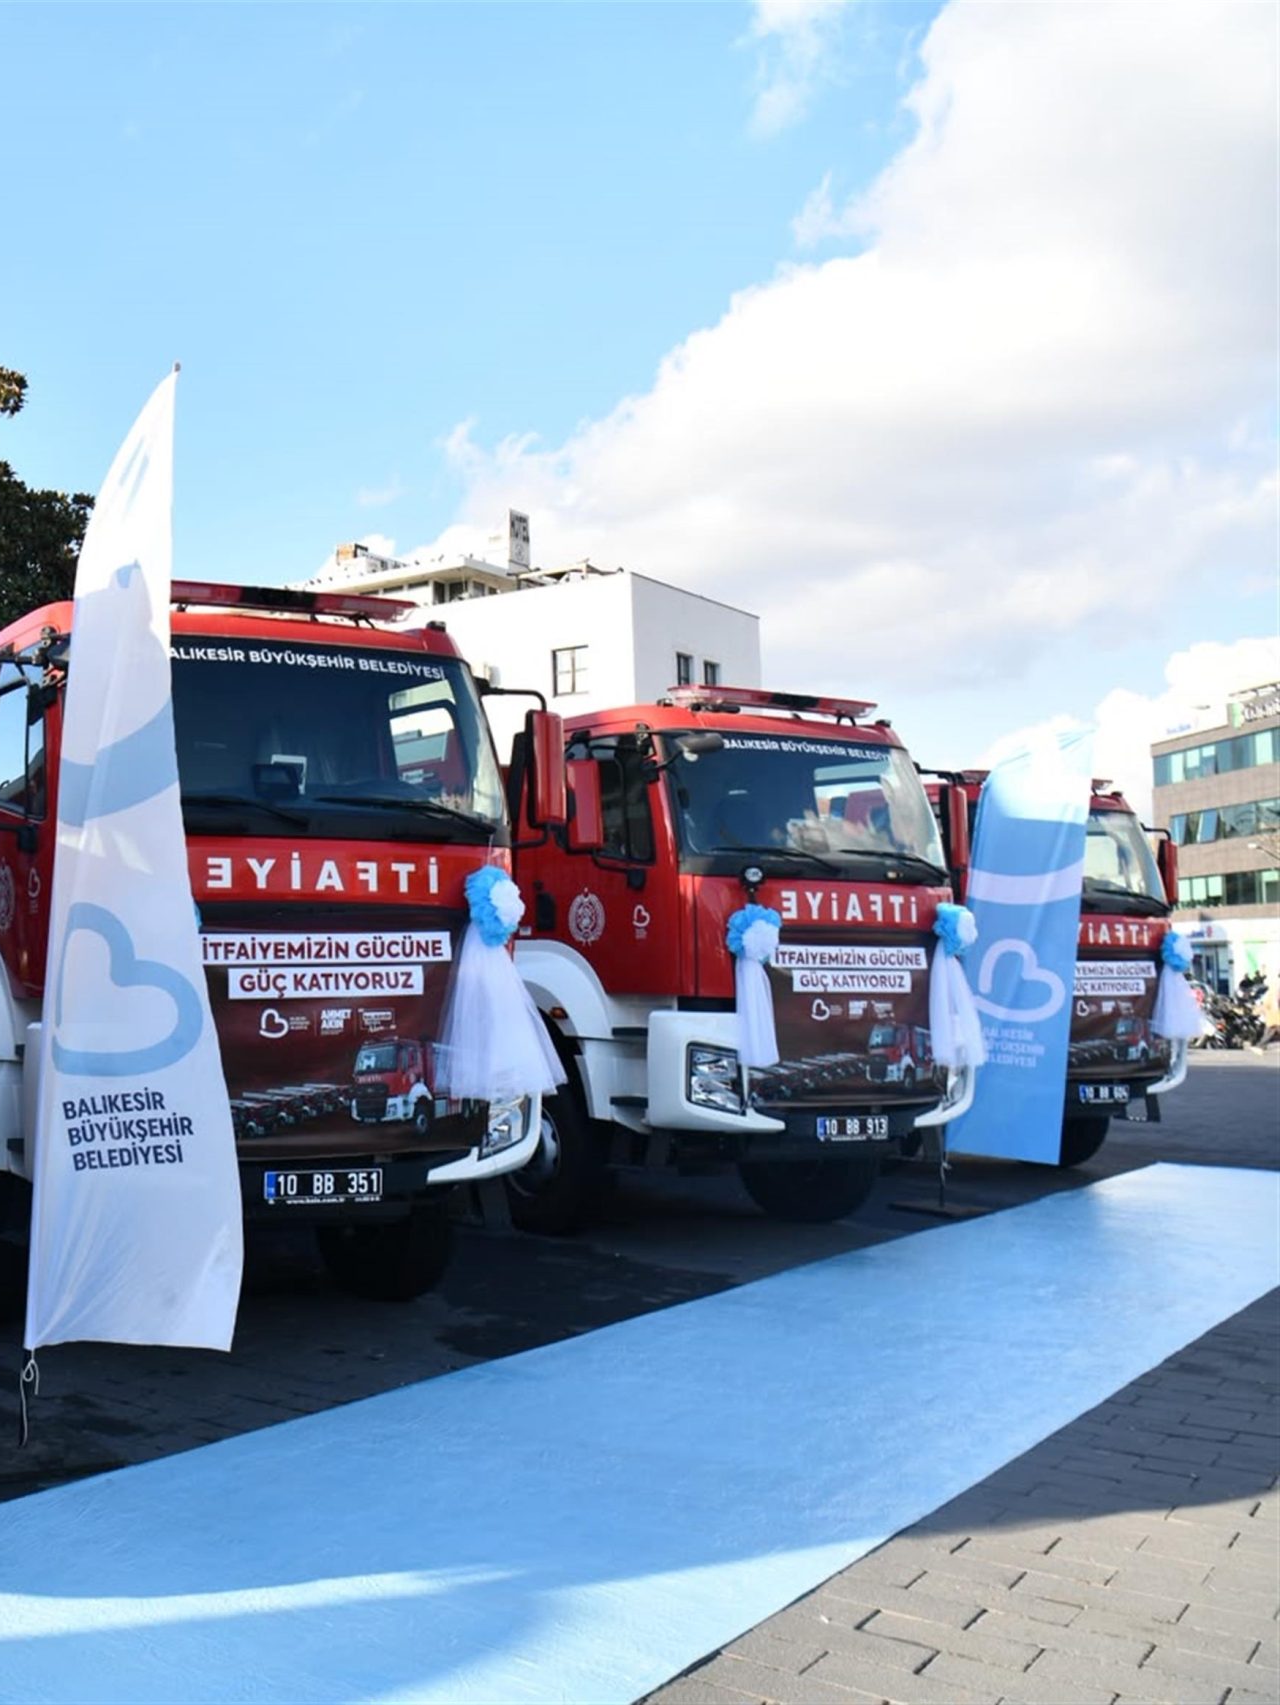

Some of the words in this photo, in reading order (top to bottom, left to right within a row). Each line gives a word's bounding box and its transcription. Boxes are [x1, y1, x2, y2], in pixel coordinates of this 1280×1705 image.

[170, 647, 245, 662] ALIKESİR
[249, 649, 355, 669] BÜYÜKŞEHİR
[358, 659, 446, 681] BELEDİYESİ
[202, 936, 349, 961] İTFAİYEMİZİN
[355, 936, 443, 959] GÜCÜNE
[870, 949, 921, 966] GÜCÜNE
[240, 969, 287, 997] GÜÇ
[293, 971, 414, 991] KATIYORUZ
[832, 975, 905, 988] KATIYORUZ
[62, 1087, 165, 1120] BALIKESİR
[67, 1116, 194, 1146] BÜYÜKŞEHİR
[72, 1138, 184, 1172] BELEDİYESİ
[278, 1174, 297, 1196] 10
[313, 1173, 334, 1195] BB
[347, 1172, 378, 1194] 351
